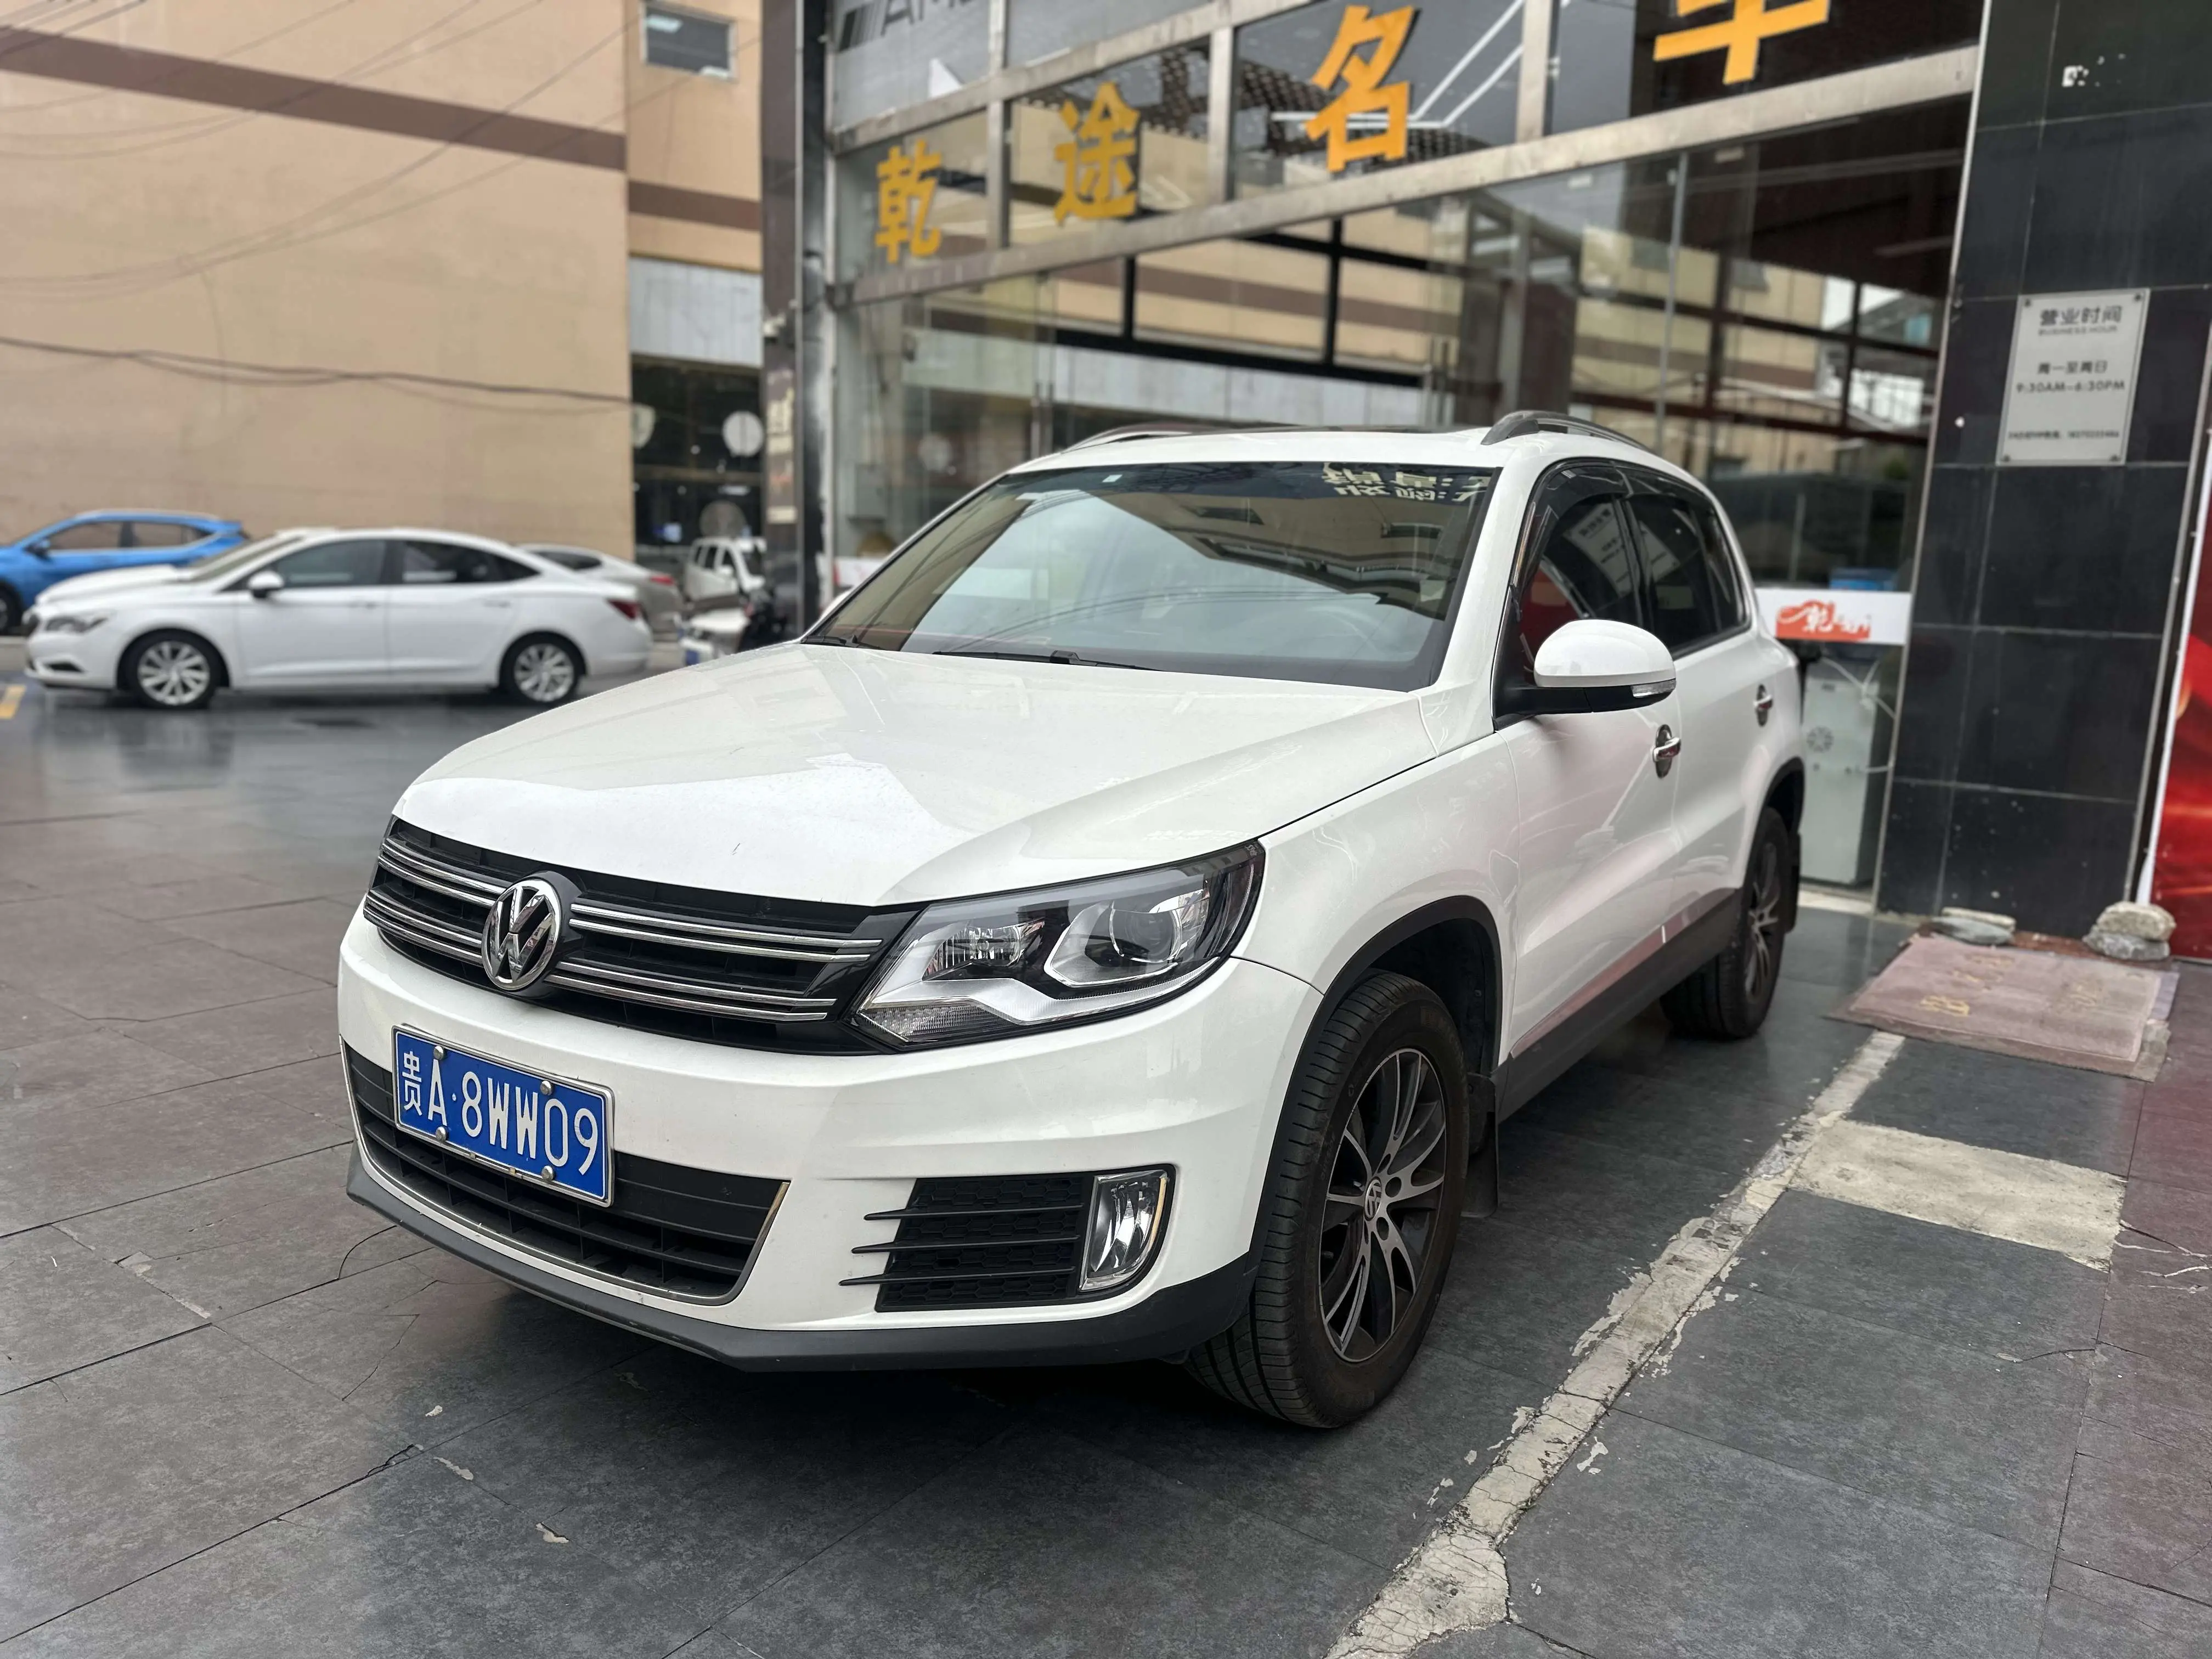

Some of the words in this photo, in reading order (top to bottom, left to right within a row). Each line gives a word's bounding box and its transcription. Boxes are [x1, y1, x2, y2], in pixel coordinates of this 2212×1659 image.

[2040, 305, 2123, 326] 营业时间
[2038, 360, 2108, 375] 周一至周日
